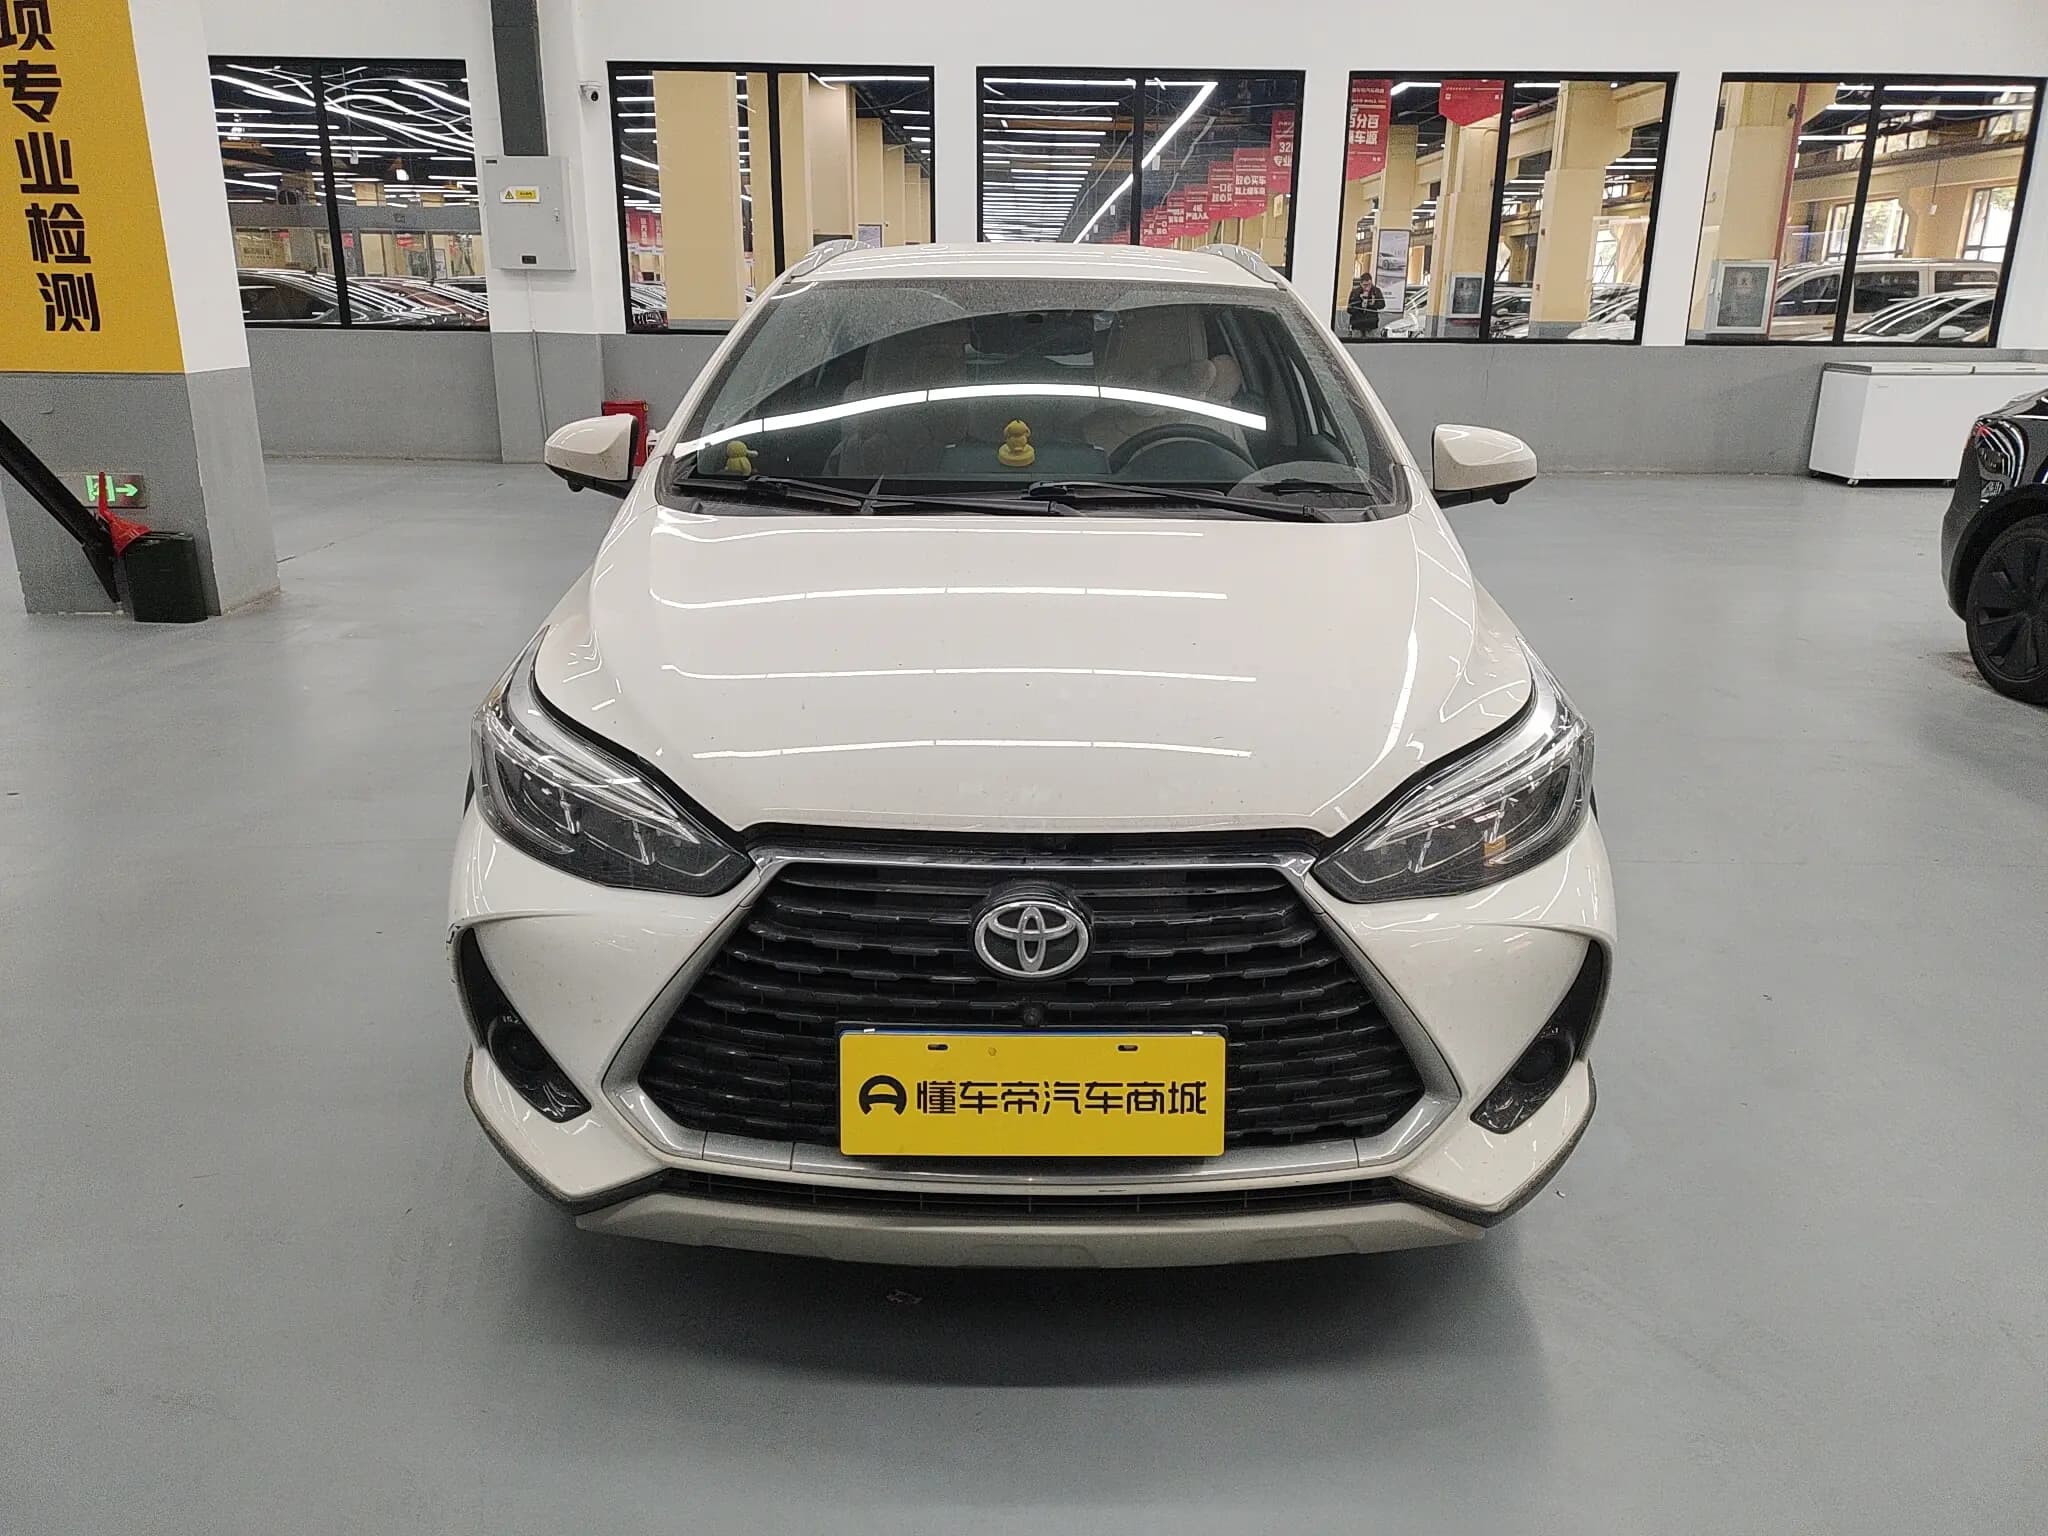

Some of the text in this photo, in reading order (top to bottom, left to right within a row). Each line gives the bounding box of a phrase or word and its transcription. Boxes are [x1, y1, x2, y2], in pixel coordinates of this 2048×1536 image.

[0, 0, 101, 331] 项专业检测
[916, 1080, 1207, 1115] 懂车帝汽车商城
